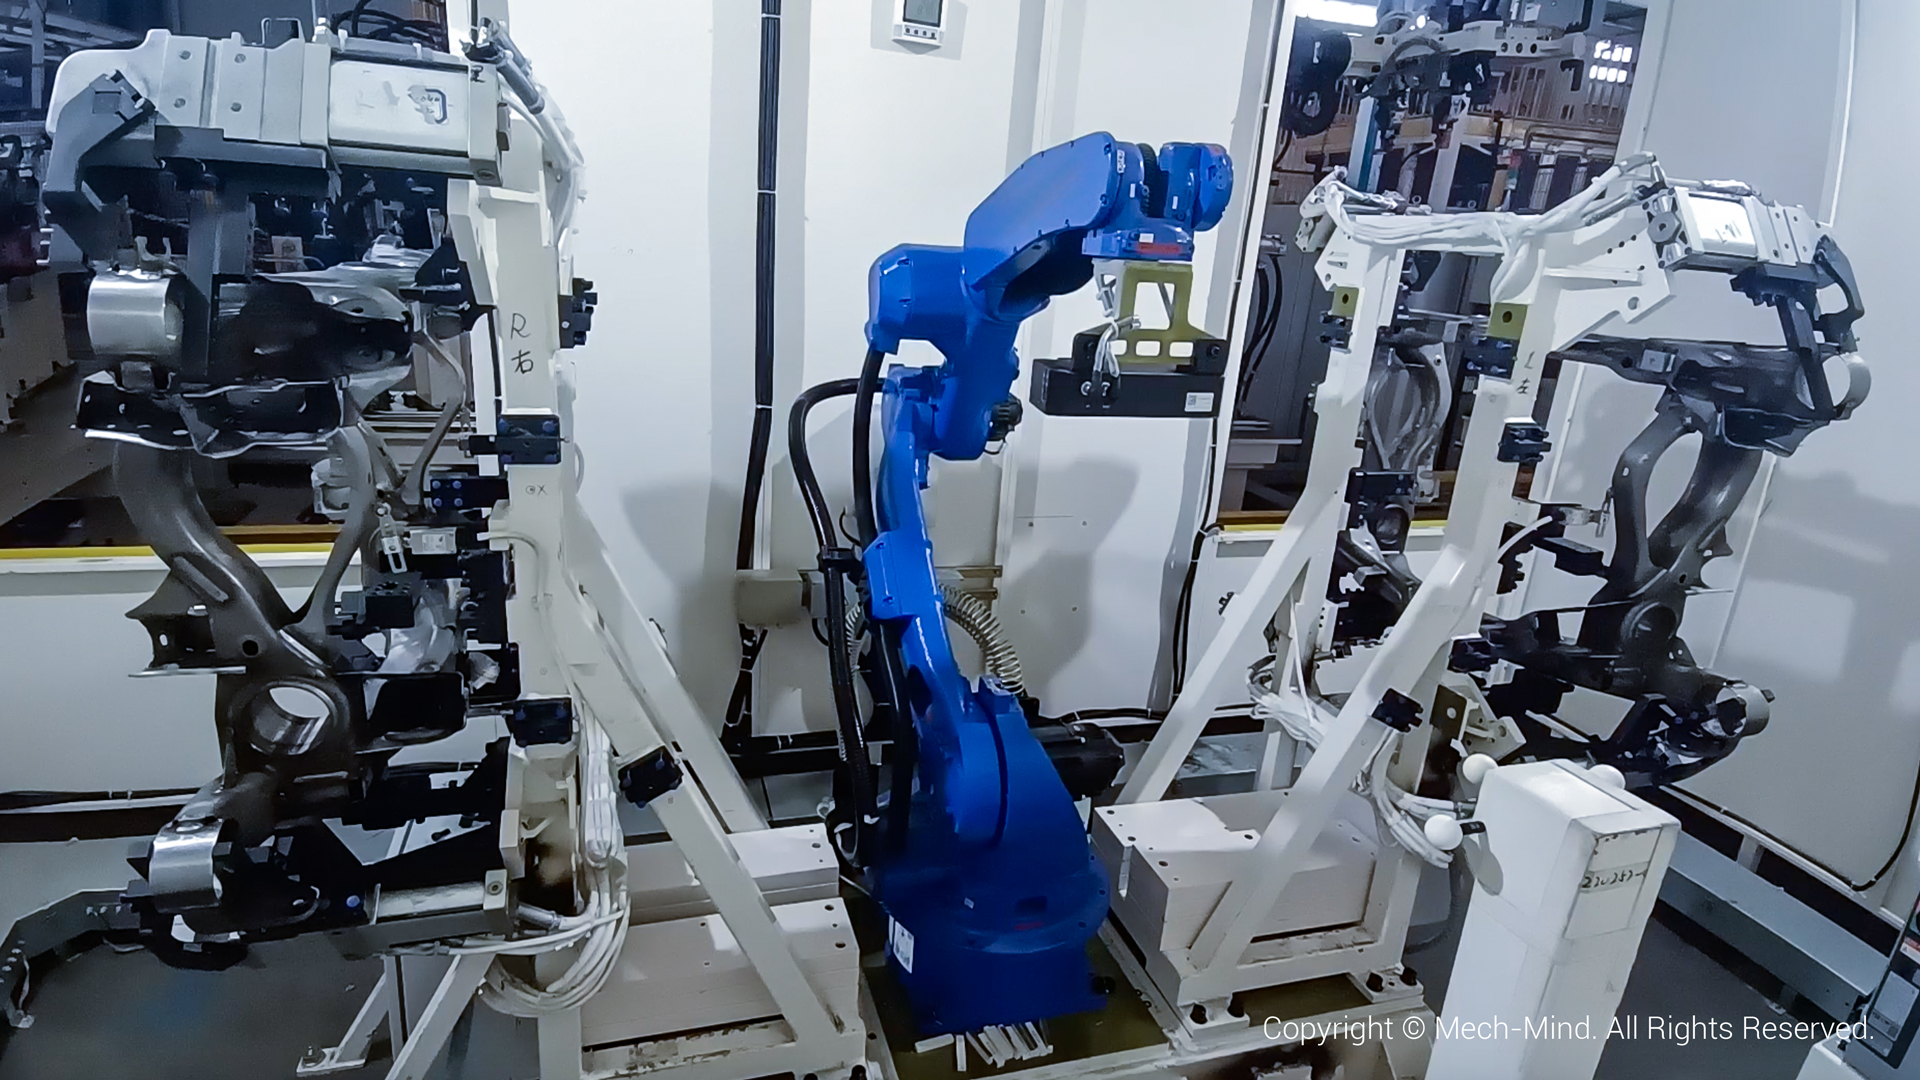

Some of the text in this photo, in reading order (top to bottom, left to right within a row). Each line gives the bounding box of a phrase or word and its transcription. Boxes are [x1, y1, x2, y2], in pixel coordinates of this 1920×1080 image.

[510, 312, 531, 340] R
[511, 349, 534, 374] 右
[1524, 350, 1535, 370] L
